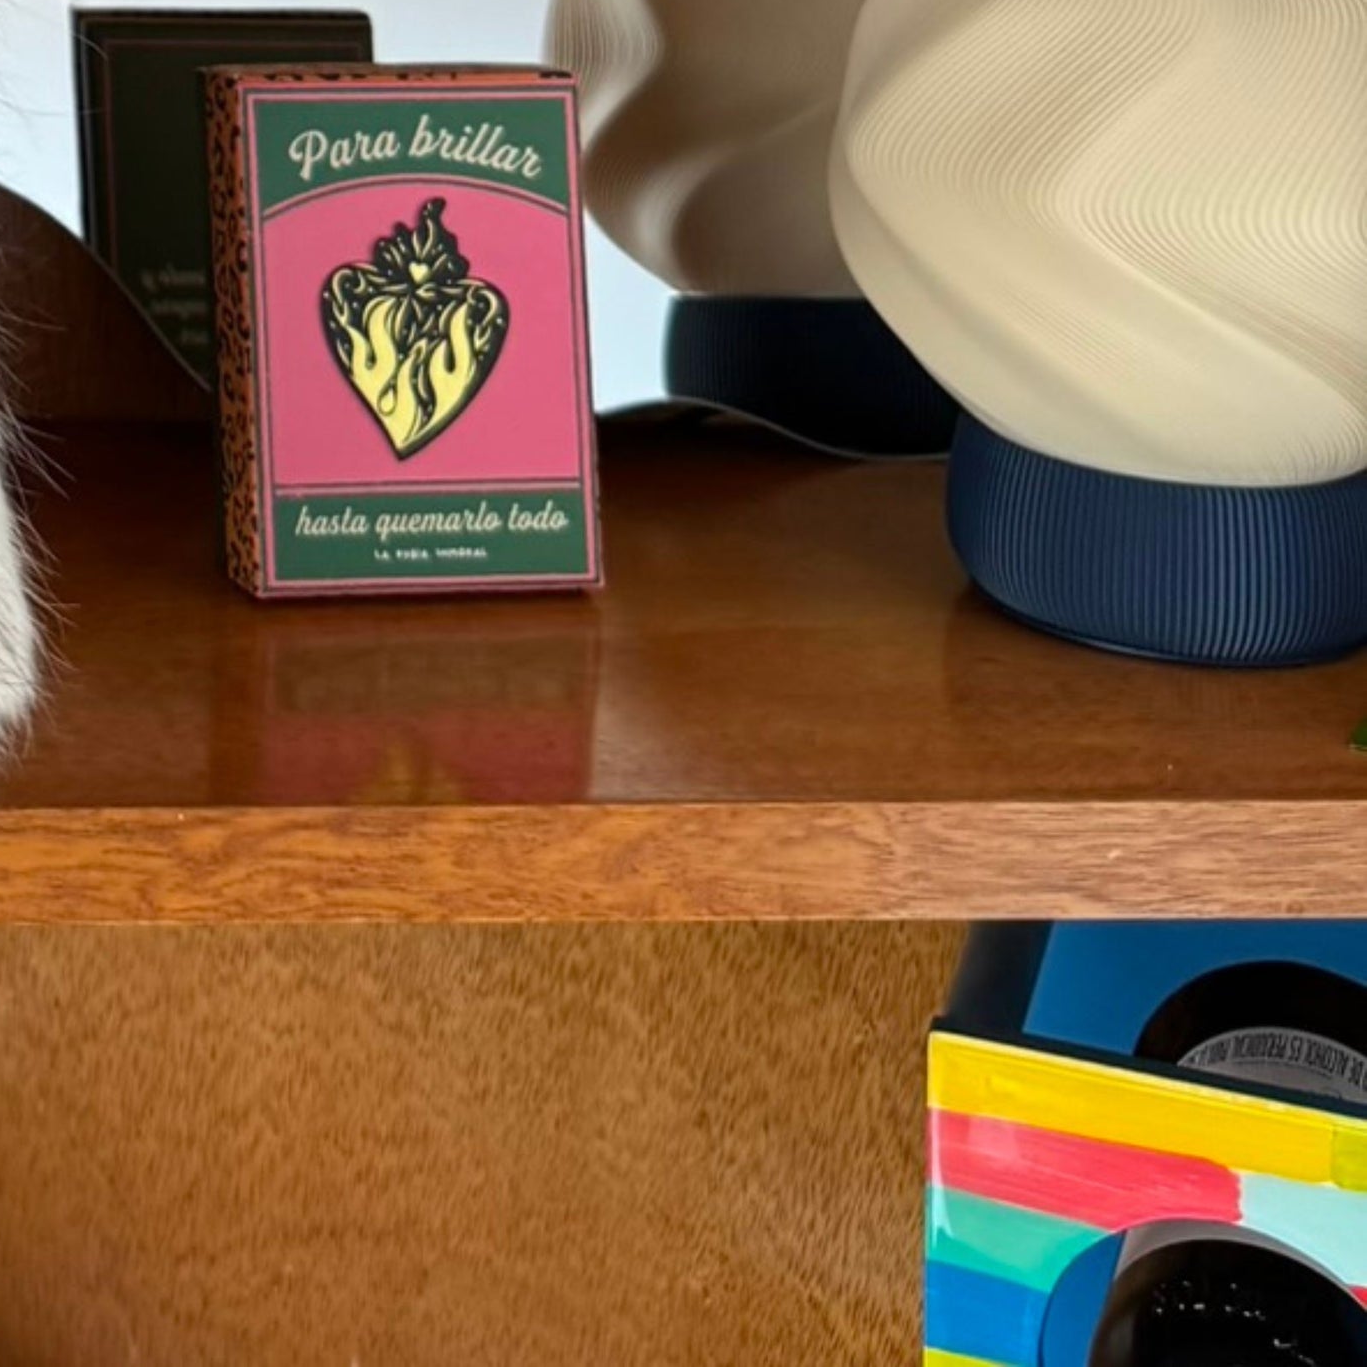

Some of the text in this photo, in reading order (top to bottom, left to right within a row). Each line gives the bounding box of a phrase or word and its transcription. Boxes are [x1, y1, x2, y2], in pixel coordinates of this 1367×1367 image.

[288, 114, 543, 181] Para brillar
[295, 499, 569, 541] hasta quemarlo todo
